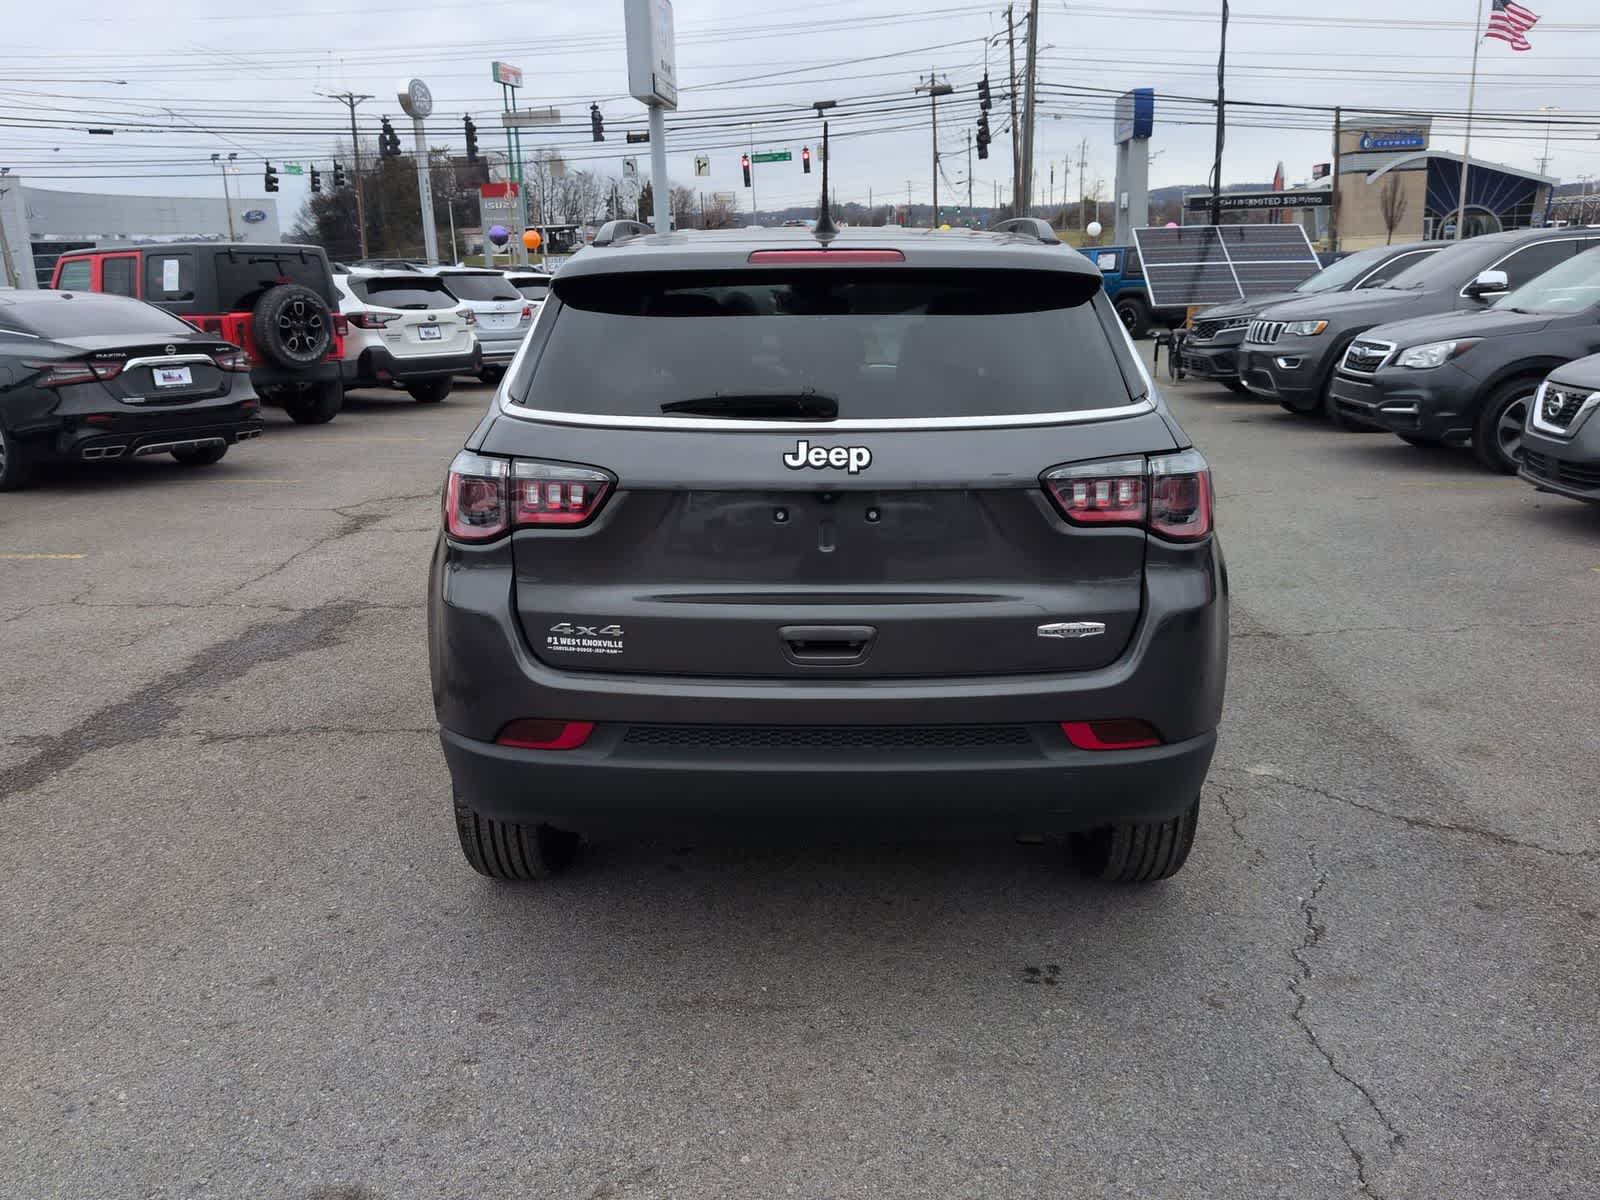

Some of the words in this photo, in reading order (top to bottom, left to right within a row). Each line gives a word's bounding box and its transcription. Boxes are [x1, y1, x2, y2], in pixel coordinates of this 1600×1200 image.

[783, 440, 871, 474] Jeep
[547, 636, 559, 645] #1
[560, 638, 581, 646] WEST
[582, 639, 623, 648] KNOXVILLE
